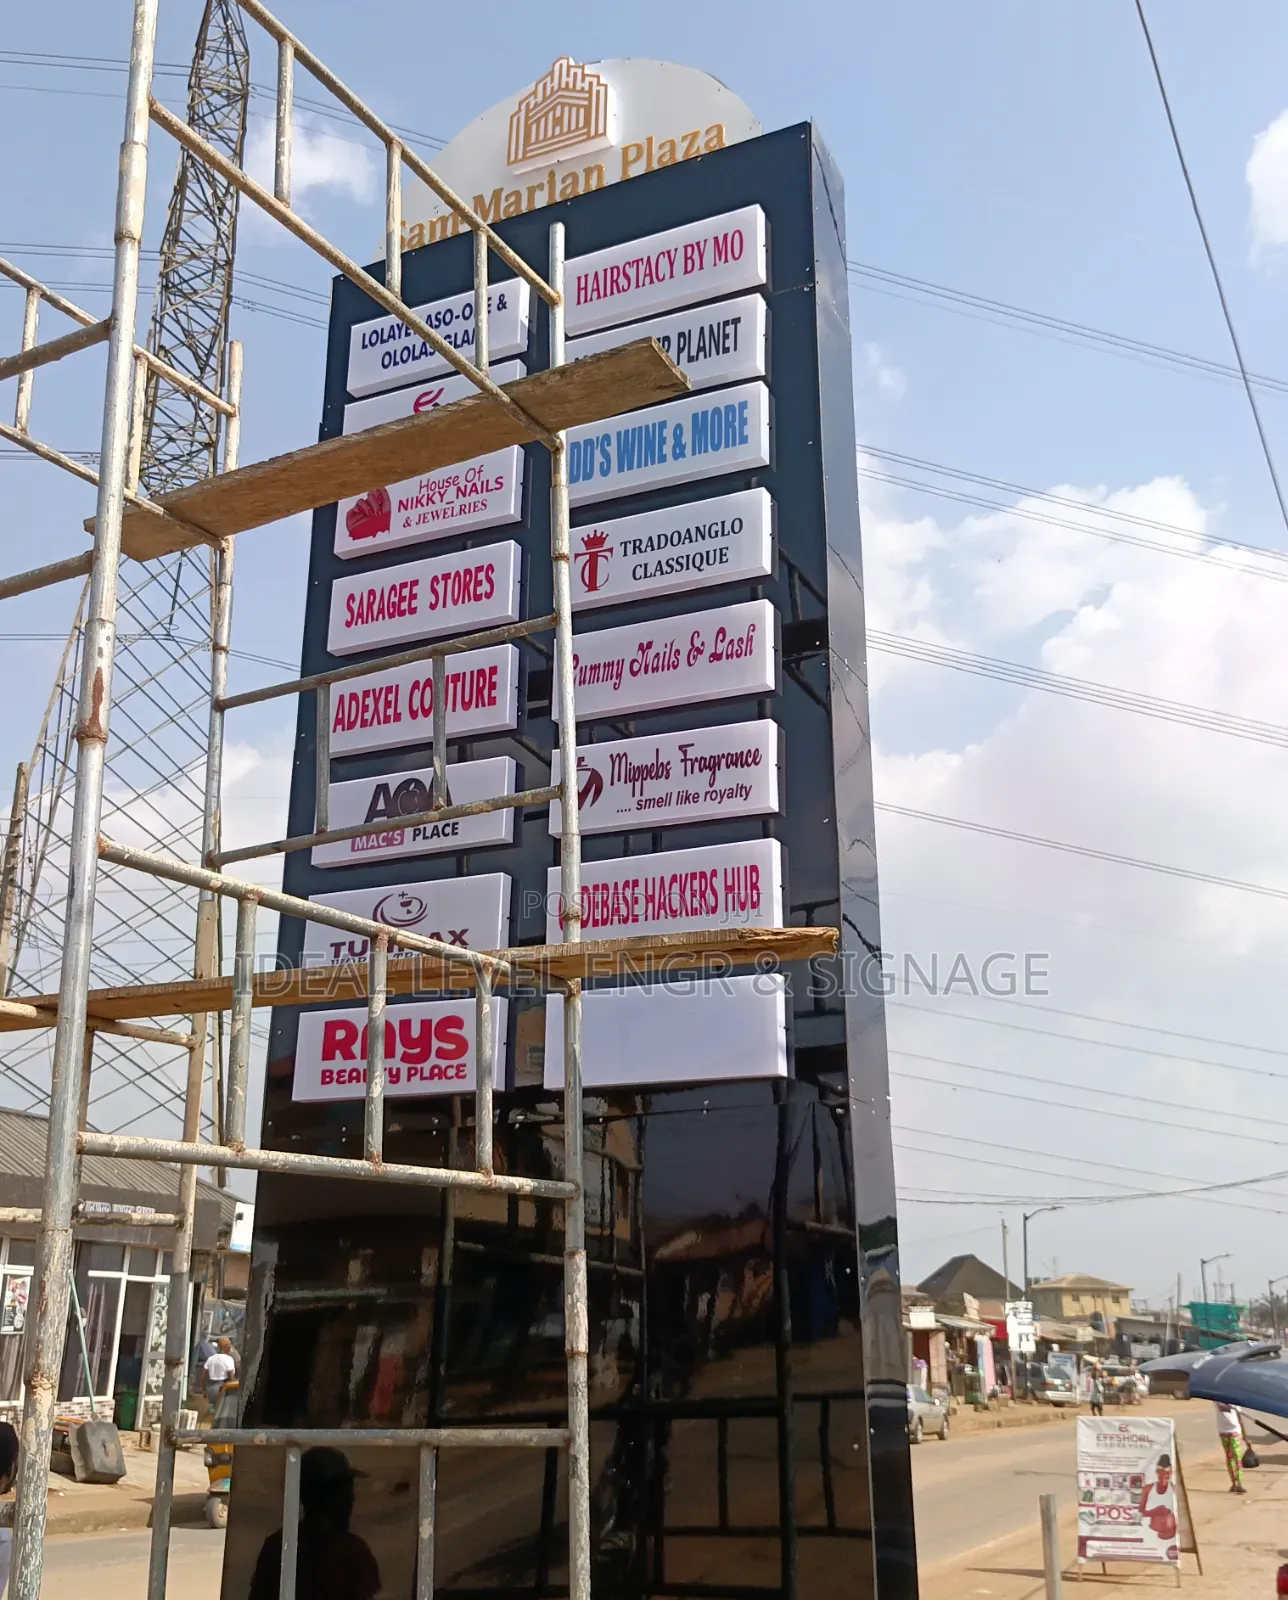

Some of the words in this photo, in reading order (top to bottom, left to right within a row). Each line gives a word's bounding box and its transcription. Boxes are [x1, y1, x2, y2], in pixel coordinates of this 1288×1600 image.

[619, 123, 727, 182] Plaza
[576, 248, 679, 305] HAIRSTACY
[683, 239, 708, 276] BY
[712, 229, 744, 267] MO
[425, 296, 492, 330] ASO-OE
[497, 293, 508, 311] &
[443, 327, 475, 350] GLA
[676, 316, 741, 366] PLANET
[569, 433, 612, 485] DD'S
[616, 419, 668, 474] WINE
[672, 422, 686, 461] &
[692, 400, 749, 457] MORE
[418, 475, 460, 495] House
[464, 464, 484, 483] Of
[402, 516, 412, 529] &
[415, 499, 487, 527] JEWELRIES
[620, 517, 744, 558] TRADOANGLO
[632, 546, 729, 581] CLASSIQUE
[345, 578, 420, 629] SARAGEE
[429, 563, 495, 611] STORES
[629, 638, 681, 677] Nails
[686, 630, 705, 667] &
[708, 623, 756, 664] Lash
[332, 683, 402, 733] ADEXEL
[678, 743, 762, 788] Fragrance
[636, 791, 673, 811] smell
[676, 789, 700, 807] like
[703, 783, 753, 804] royalty
[354, 829, 402, 851] MAC'S
[412, 821, 460, 842] PLACE
[558, 879, 639, 932] DEBASE
[644, 868, 719, 922] HACKERS
[723, 864, 760, 913] HUB
[320, 1066, 401, 1086] BEAY
[407, 1063, 468, 1082] PLACE
[1096, 1505, 1132, 1520] POS
